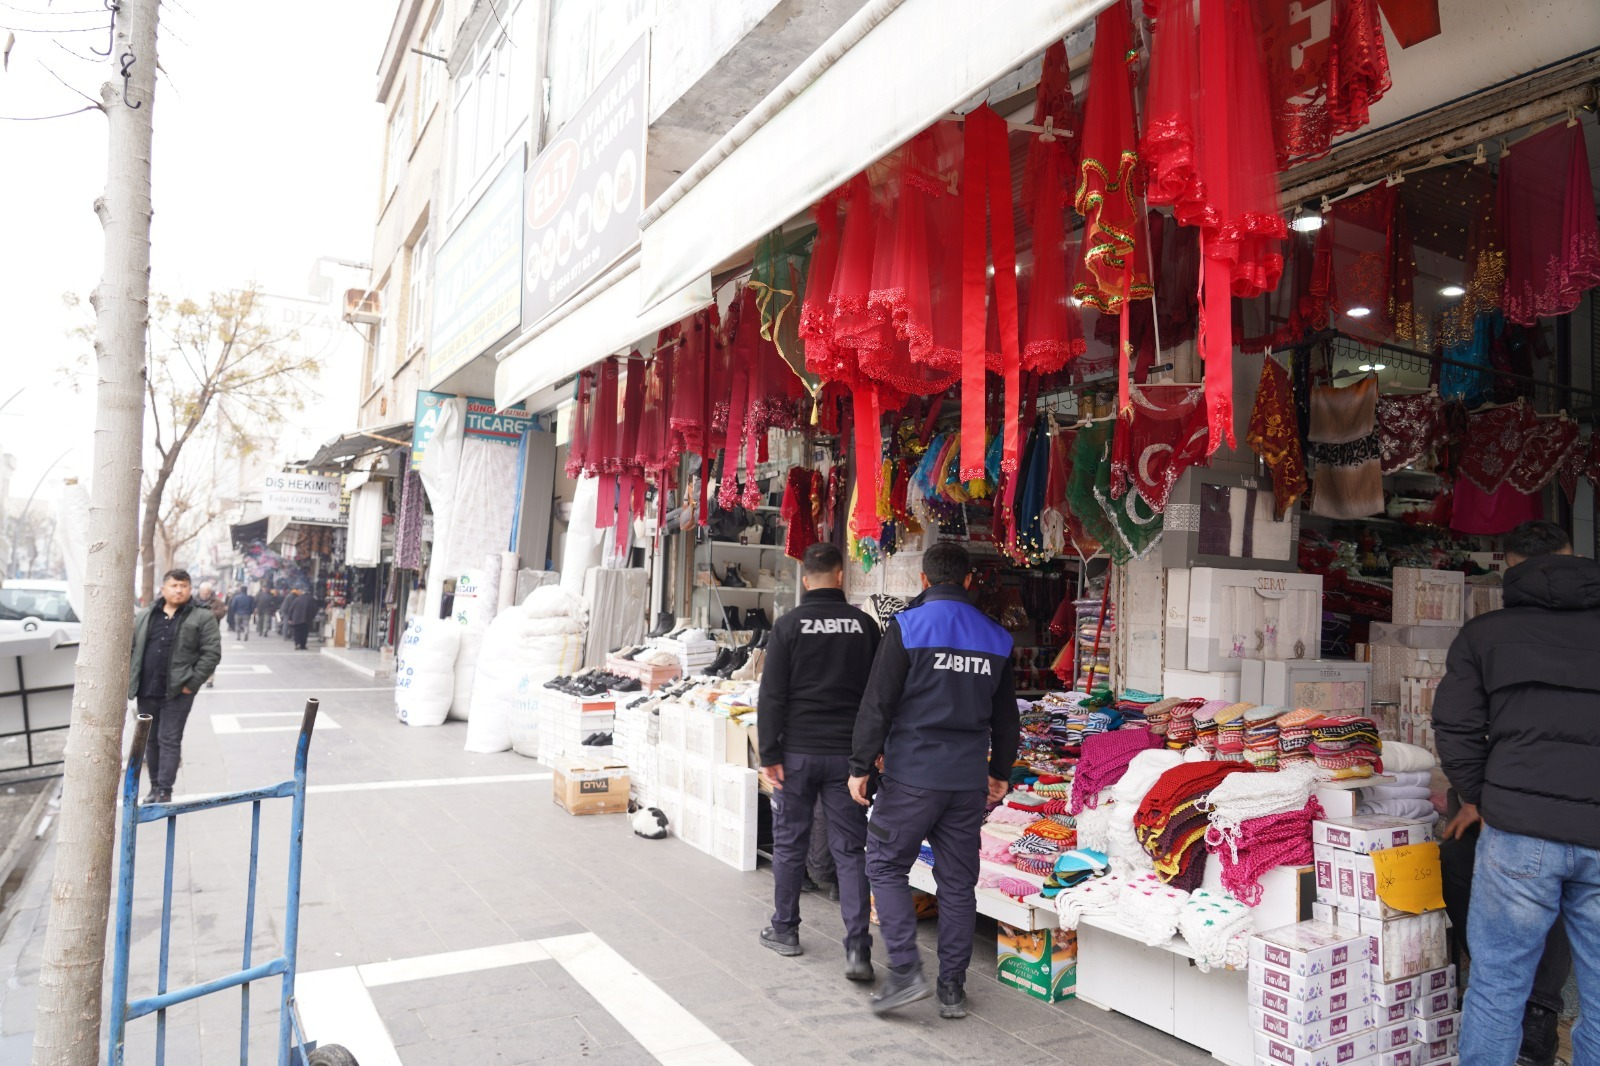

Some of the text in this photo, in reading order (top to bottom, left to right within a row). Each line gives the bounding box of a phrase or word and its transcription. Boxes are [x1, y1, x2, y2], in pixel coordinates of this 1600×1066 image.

[579, 56, 642, 145] AYAKKABI
[582, 103, 635, 171] & ÇANTA
[288, 479, 329, 492] HEKİMİ
[1257, 577, 1287, 591] SERAY
[800, 618, 863, 635] ZABITA
[933, 653, 992, 676] ZABITA
[583, 781, 608, 789] TALO
[1414, 868, 1432, 881] 250
